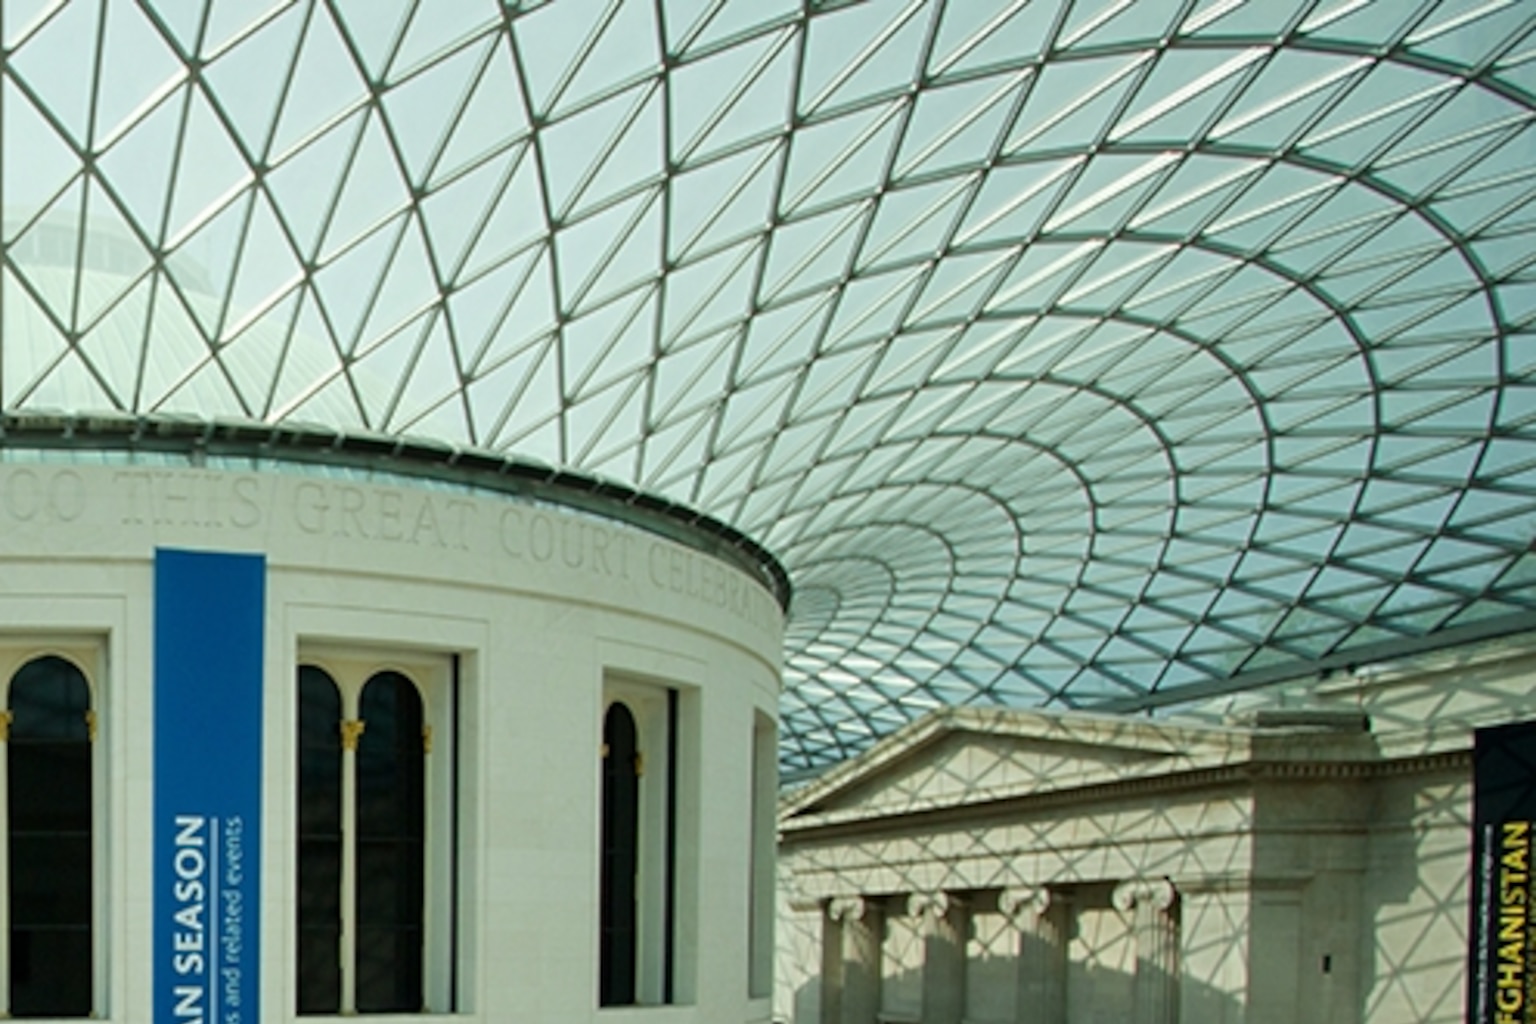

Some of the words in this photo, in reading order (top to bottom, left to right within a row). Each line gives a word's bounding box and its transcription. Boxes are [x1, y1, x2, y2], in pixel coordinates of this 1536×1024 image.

[112, 470, 263, 529] THIS
[291, 481, 478, 552] GREAT
[499, 507, 635, 580] COURT
[224, 816, 243, 885] events
[174, 815, 205, 975] SEASON
[221, 890, 242, 962] related
[221, 967, 241, 1007] and
